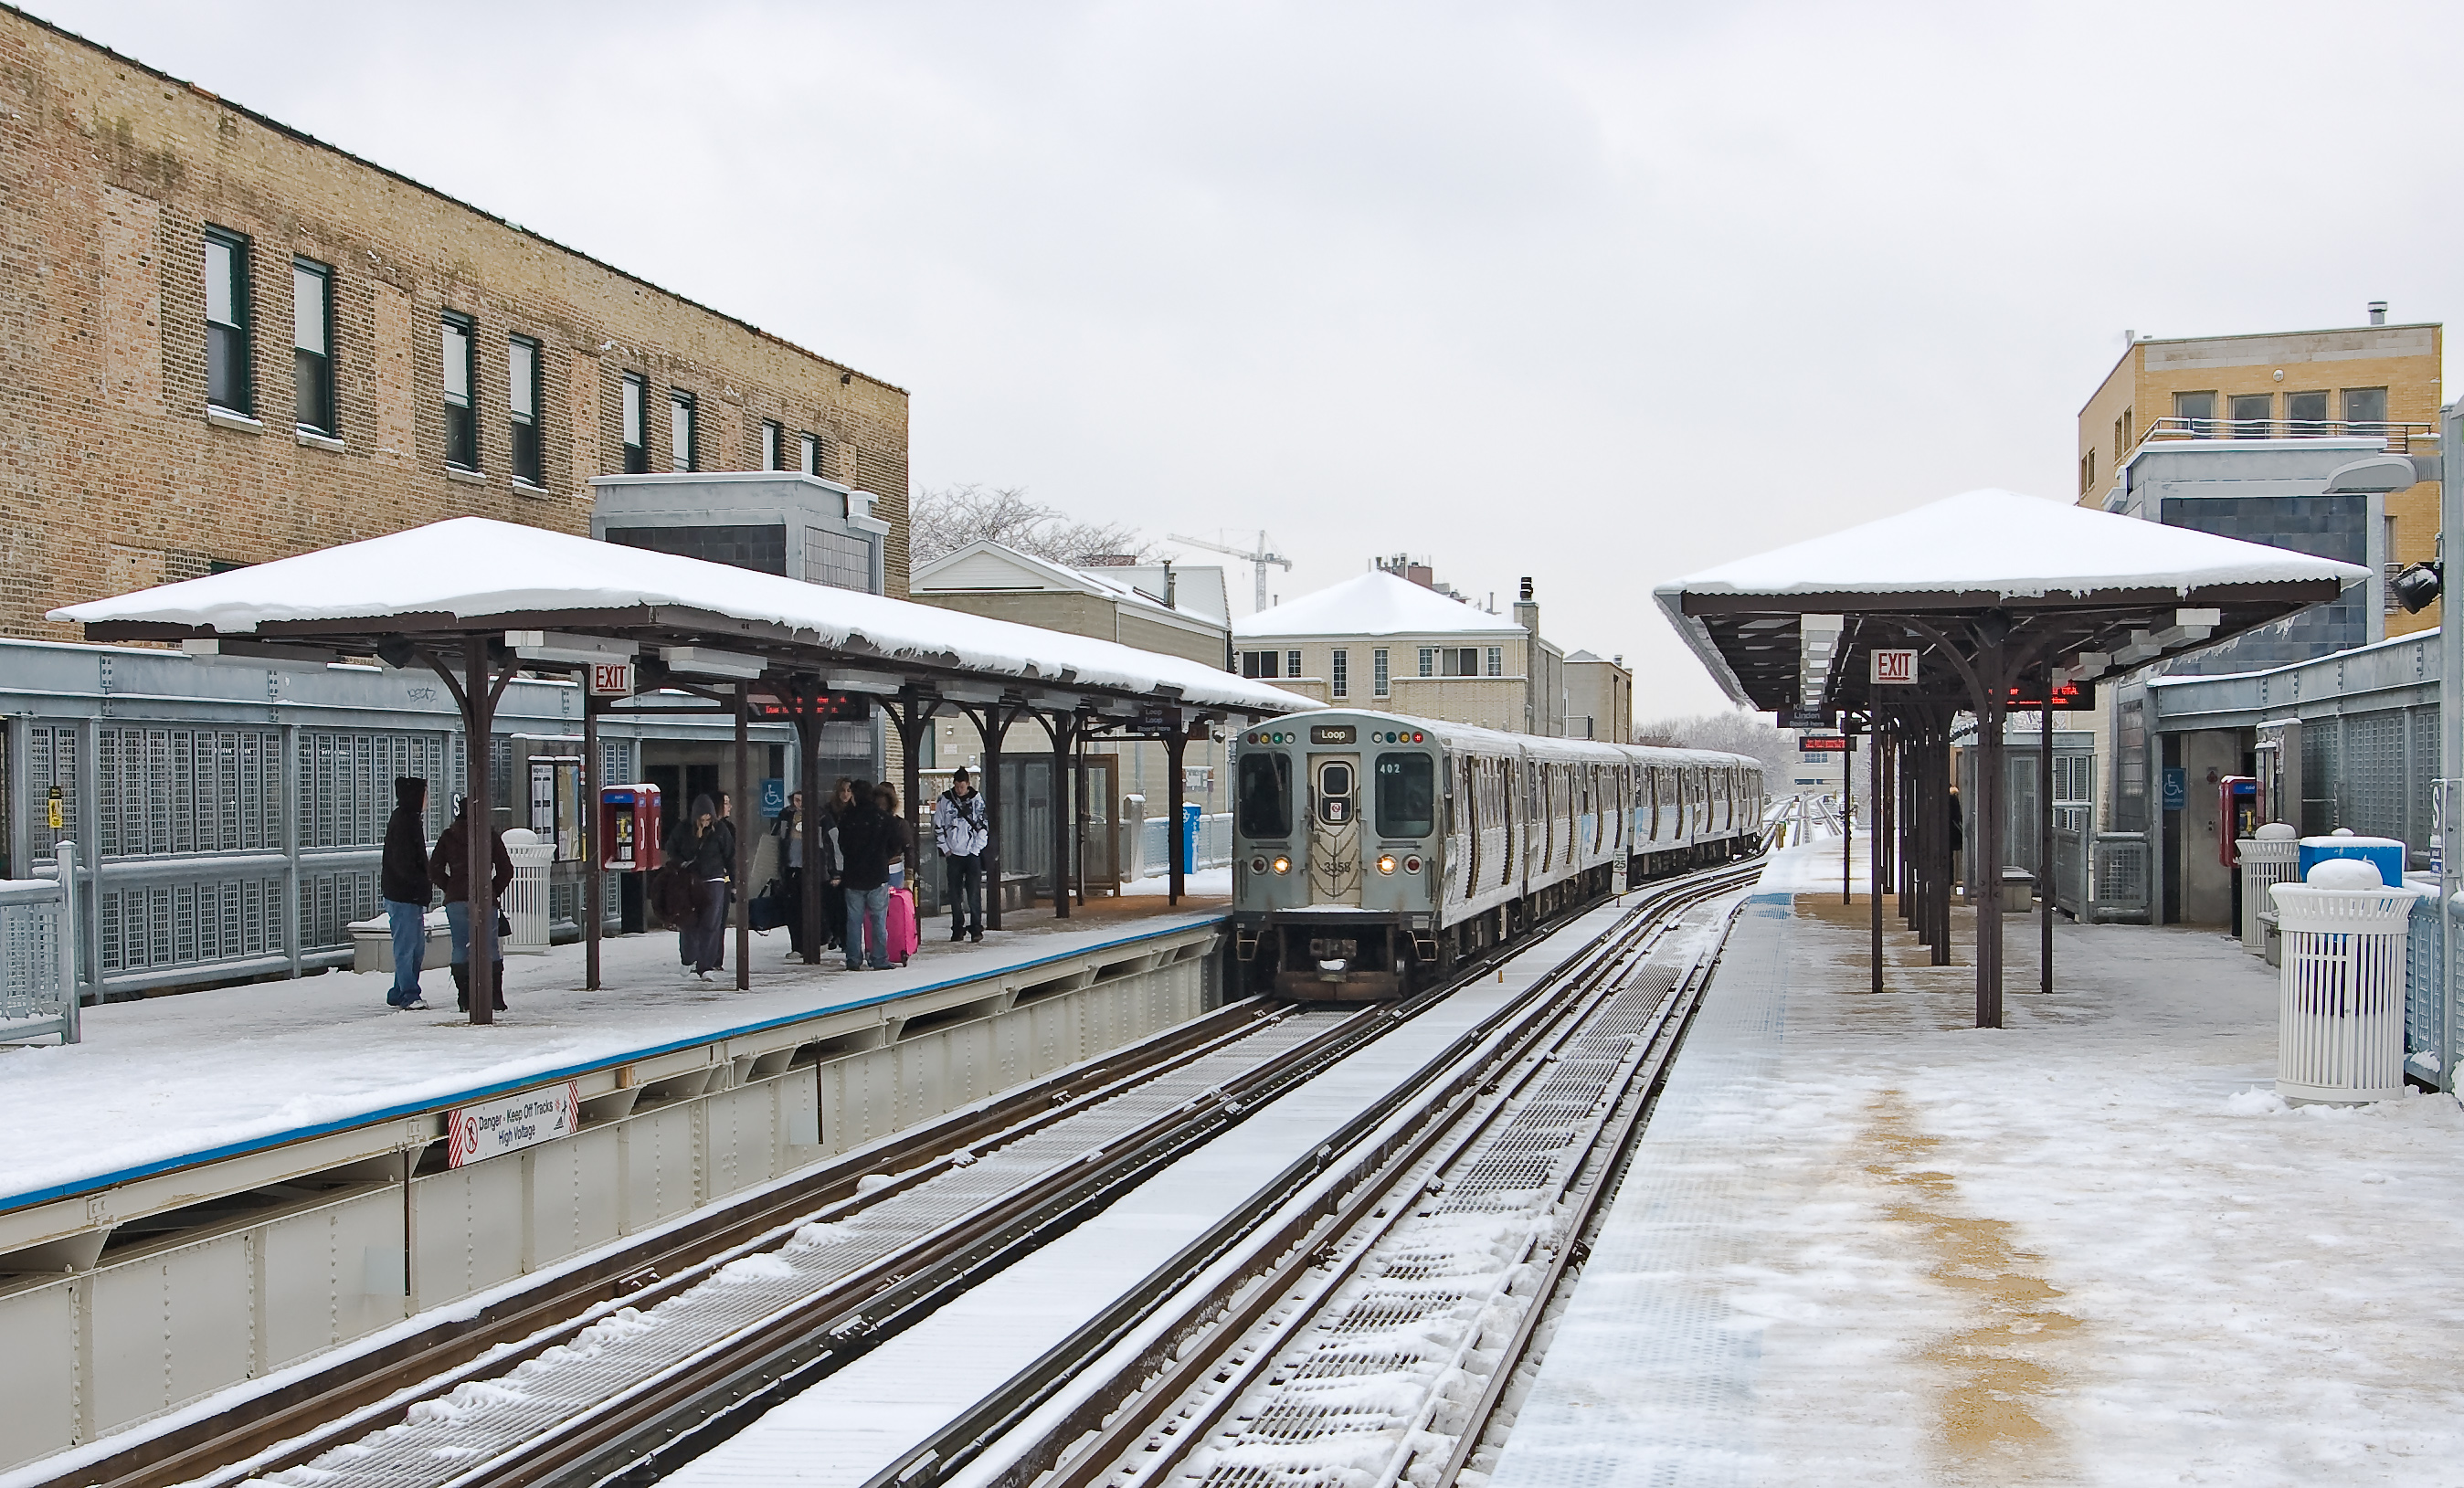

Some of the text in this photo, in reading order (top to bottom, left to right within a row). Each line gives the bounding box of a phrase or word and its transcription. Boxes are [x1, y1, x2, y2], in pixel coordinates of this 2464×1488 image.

[1878, 653, 1911, 676] EXIT
[596, 666, 626, 688] EXIT
[1145, 716, 1162, 724] Loop
[1321, 730, 1346, 740] Loop
[1380, 764, 1401, 774] 402
[1324, 862, 1351, 873] 3358
[1613, 860, 1626, 869] 25
[479, 1115, 502, 1132] Danger
[506, 1109, 523, 1124] Keep
[523, 1103, 534, 1119] Off
[534, 1100, 554, 1116] Tracks
[498, 1124, 536, 1146] High Voltage
